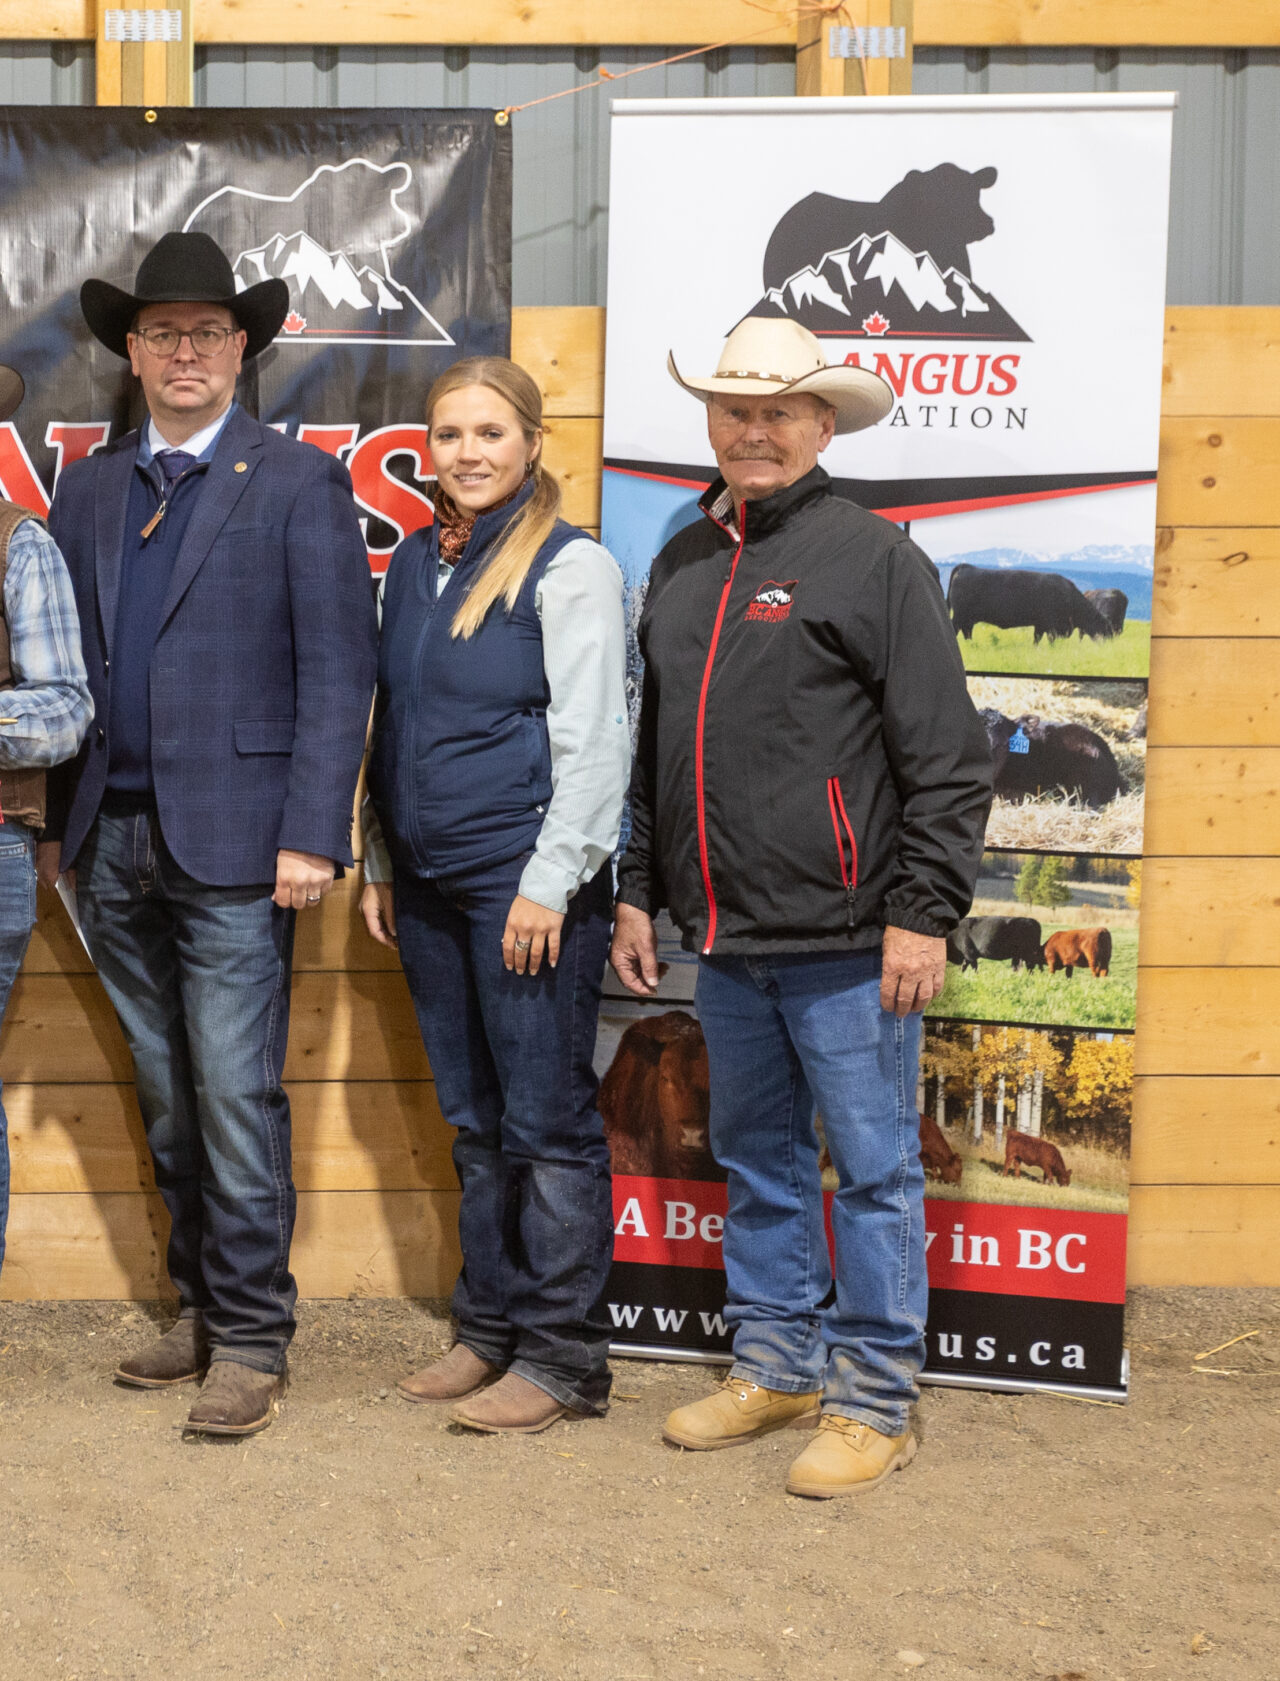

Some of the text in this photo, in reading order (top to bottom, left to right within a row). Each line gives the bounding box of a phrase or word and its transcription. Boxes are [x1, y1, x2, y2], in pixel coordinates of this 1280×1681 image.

[614, 1197, 650, 1237] A
[950, 1224, 1001, 1267] in
[1016, 1228, 1087, 1274] BC
